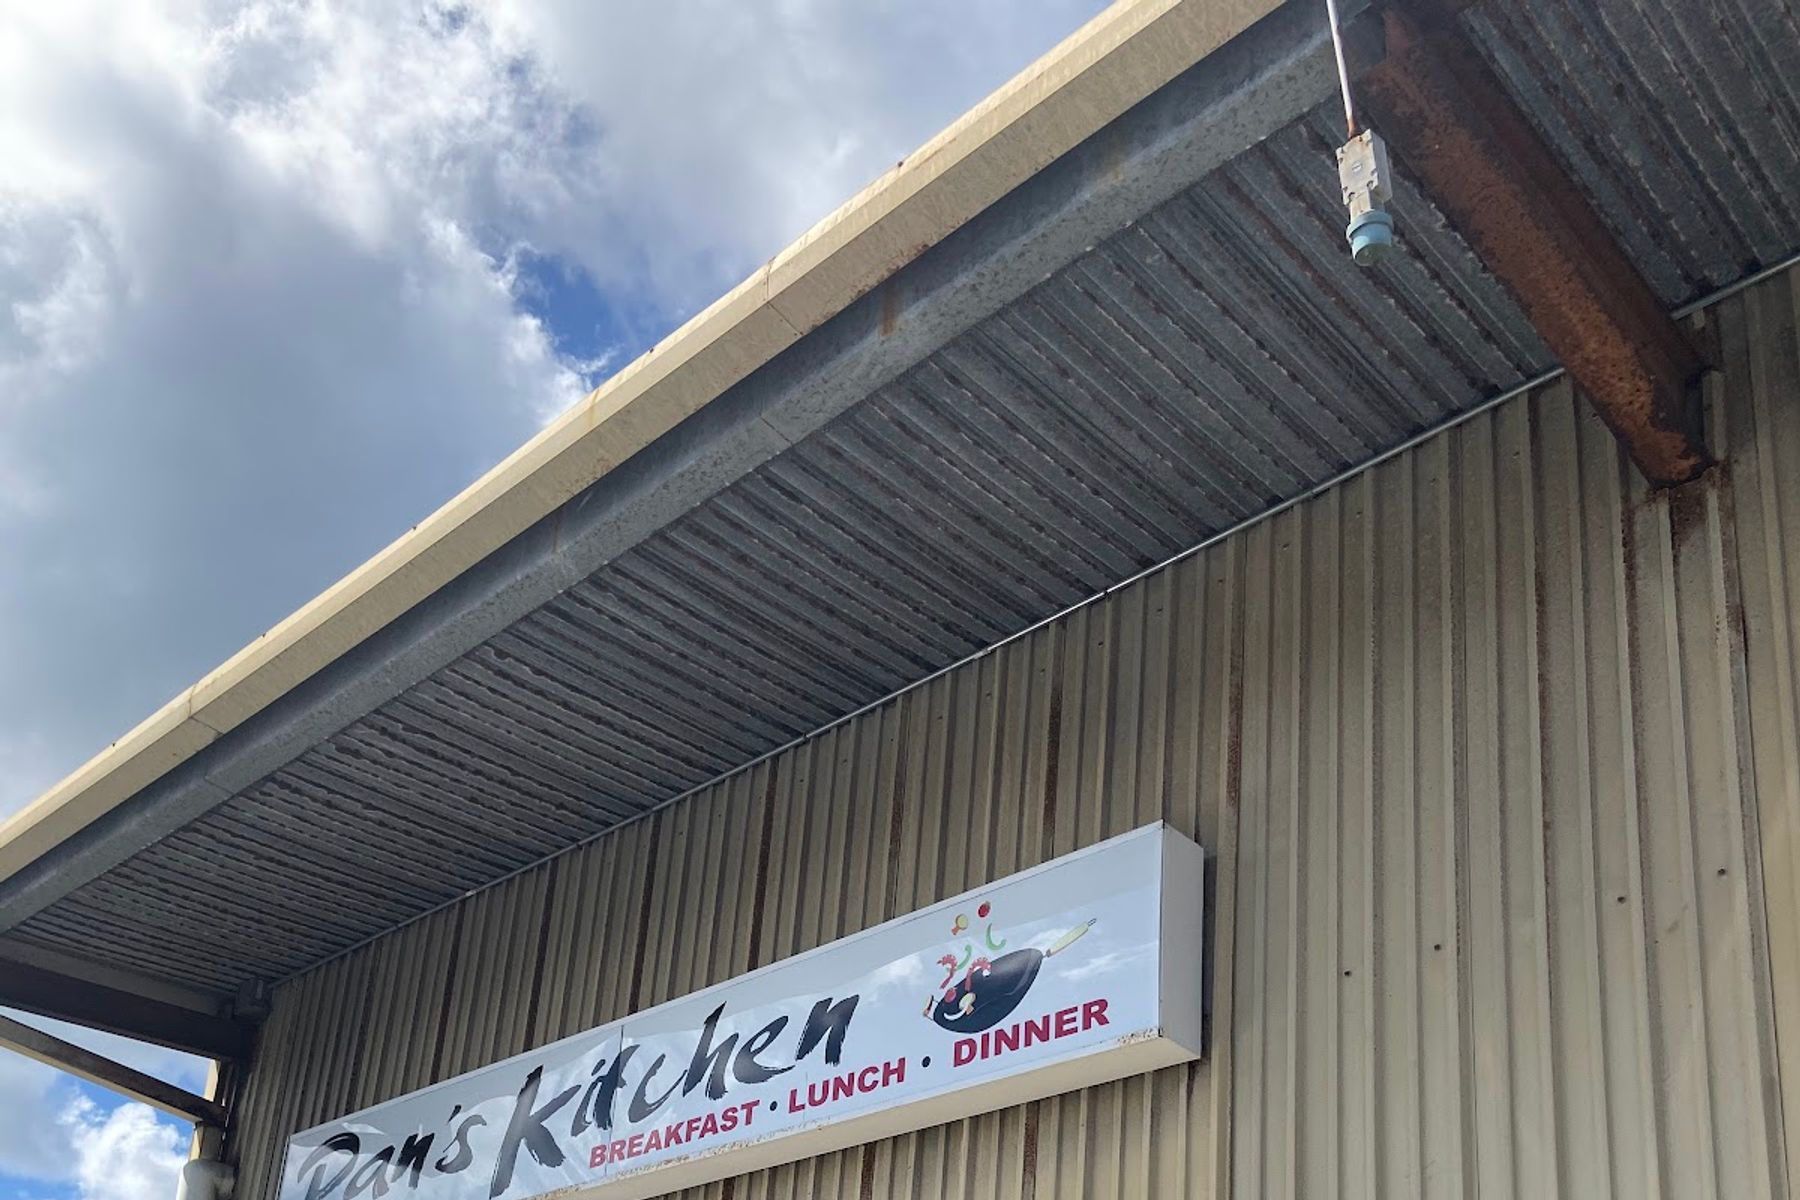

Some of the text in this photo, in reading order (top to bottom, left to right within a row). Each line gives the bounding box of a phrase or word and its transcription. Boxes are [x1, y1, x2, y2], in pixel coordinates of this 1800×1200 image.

[490, 993, 860, 1199] Kitchen
[588, 998, 1110, 1170] BREAKFAST LUNCH DINNER
